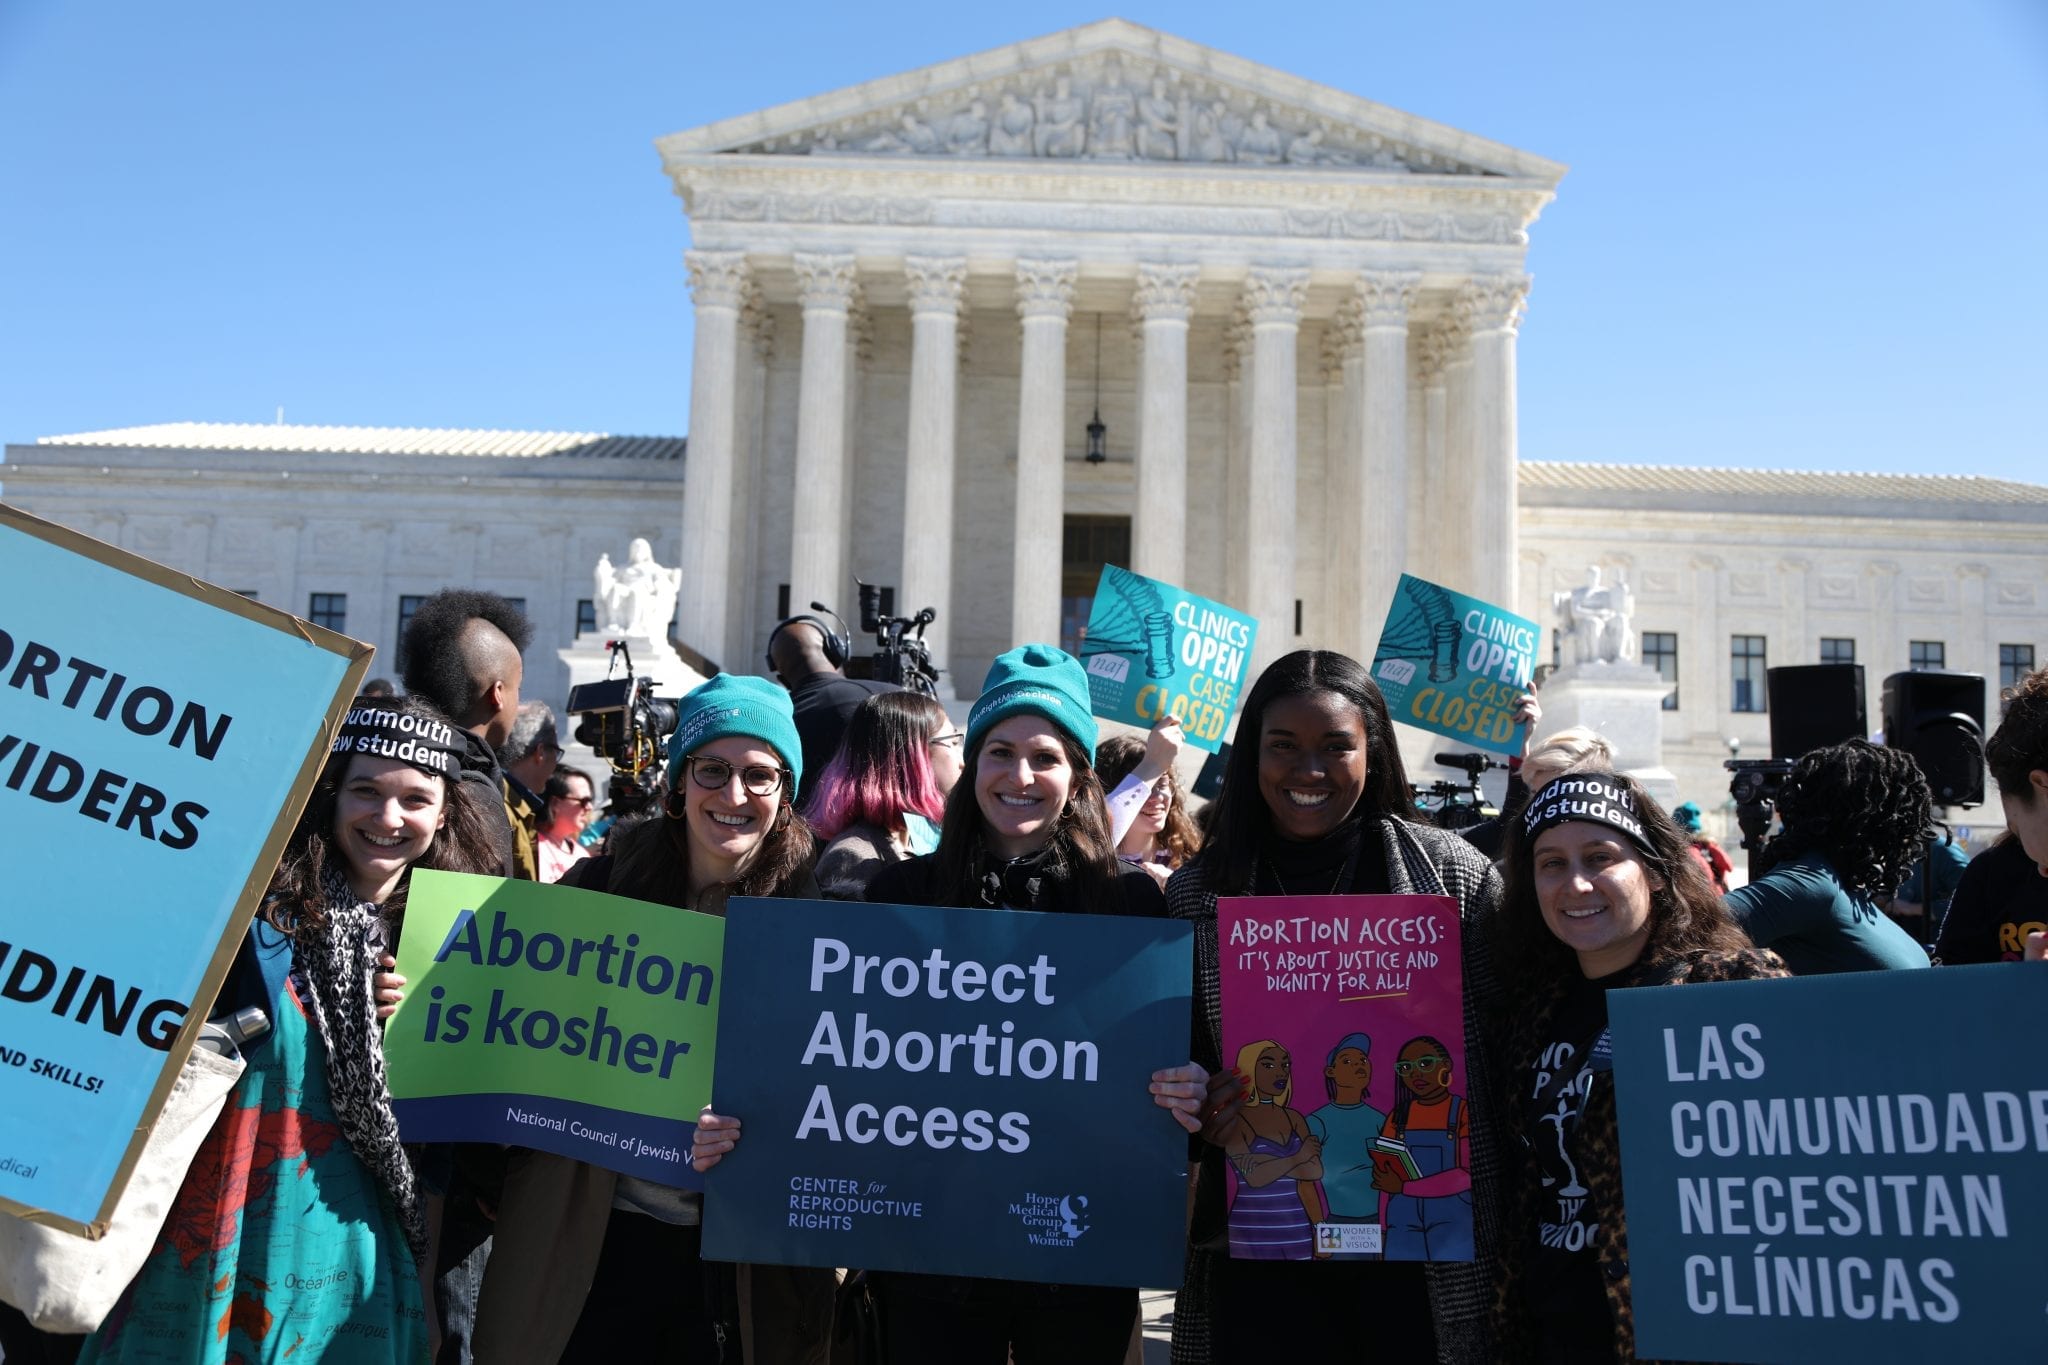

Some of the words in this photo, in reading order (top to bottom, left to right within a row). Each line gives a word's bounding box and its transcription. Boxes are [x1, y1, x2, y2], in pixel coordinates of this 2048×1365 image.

[1174, 601, 1249, 649] CLINICS
[1464, 609, 1535, 655] CLINICS
[1092, 657, 1126, 680] naf
[1181, 631, 1245, 685] OPEN
[1384, 662, 1413, 683] naf
[1466, 638, 1532, 689] OPEN
[0, 628, 233, 761] RTION
[1188, 672, 1234, 709] CASE
[1468, 677, 1524, 713] CASE
[343, 708, 452, 746] oudmouth
[1134, 684, 1225, 742] CLOSED
[1411, 687, 1515, 744] CLOSED
[332, 735, 354, 752] aw
[356, 734, 449, 771] student
[1524, 780, 1639, 823] oudmout
[1525, 811, 1541, 836] aw
[1544, 798, 1643, 836] student
[1229, 916, 1350, 948] ABORTION
[1359, 915, 1445, 946] ACCESS:
[433, 908, 714, 1006] Abortion
[809, 937, 1057, 1006] Protect
[1239, 951, 1270, 971] IT'S
[1276, 950, 1331, 971] ABOUT
[1336, 950, 1401, 971] JUSTICE
[1406, 950, 1439, 970] AND
[1266, 972, 1332, 993] DIGNITY
[1338, 971, 1371, 993] FOR
[1375, 972, 1411, 991] ALL!
[423, 985, 473, 1044] is
[483, 989, 691, 1081] kosher
[800, 1010, 1100, 1083] Abortion
[1531, 1041, 1575, 1071] NO
[1663, 1022, 1766, 1083] LAS
[29, 1058, 104, 1094] SKILLS!
[506, 1107, 567, 1132] National
[570, 1121, 617, 1147] Council
[620, 1137, 637, 1152] of
[634, 1139, 680, 1164] Jewish
[795, 1084, 1032, 1154] Access
[1670, 1090, 2048, 1158] COMUNIDADE
[0, 1155, 39, 1180] dical
[790, 1176, 859, 1195] CENTER
[863, 1181, 888, 1196] for
[789, 1194, 923, 1218] REPRODUCTIVE
[1008, 1203, 1059, 1217] Medical
[1025, 1192, 1060, 1207] Hope
[1677, 1174, 2008, 1239] NECESITAN
[788, 1213, 853, 1231] RIGHTS
[1022, 1214, 1063, 1230] Group
[1028, 1233, 1075, 1247] Women
[1045, 1228, 1060, 1238] for
[1343, 1227, 1379, 1235] WOMEN
[1346, 1241, 1377, 1249] VISION
[284, 1269, 348, 1290] Océanie
[1684, 1244, 1960, 1324] CLÍNICAS
[322, 1322, 390, 1340] PACIFIQUE
